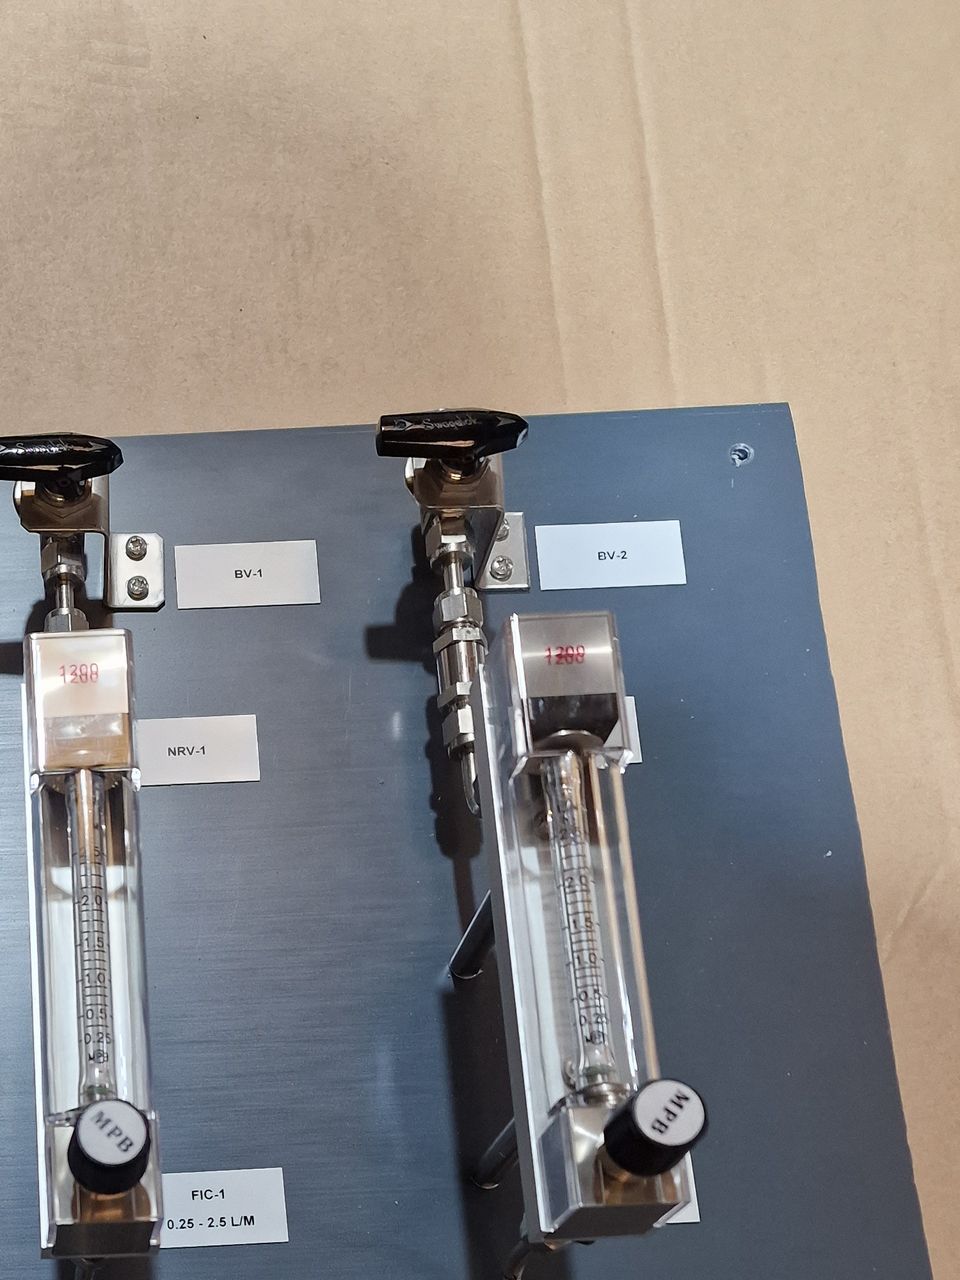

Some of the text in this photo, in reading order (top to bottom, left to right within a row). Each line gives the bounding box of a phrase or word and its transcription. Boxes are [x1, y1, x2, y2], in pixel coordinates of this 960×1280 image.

[597, 550, 628, 561] BV-2
[234, 568, 263, 579] BV-1
[167, 746, 207, 757] NRV-1
[84, 1031, 112, 1045] 0.25
[651, 1090, 690, 1135] MPB
[92, 1110, 135, 1153] MPB
[191, 1188, 225, 1201] FIC-1
[167, 1218, 194, 1230] 0.25
[207, 1216, 227, 1228] 2.5
[231, 1215, 255, 1227] L/M
